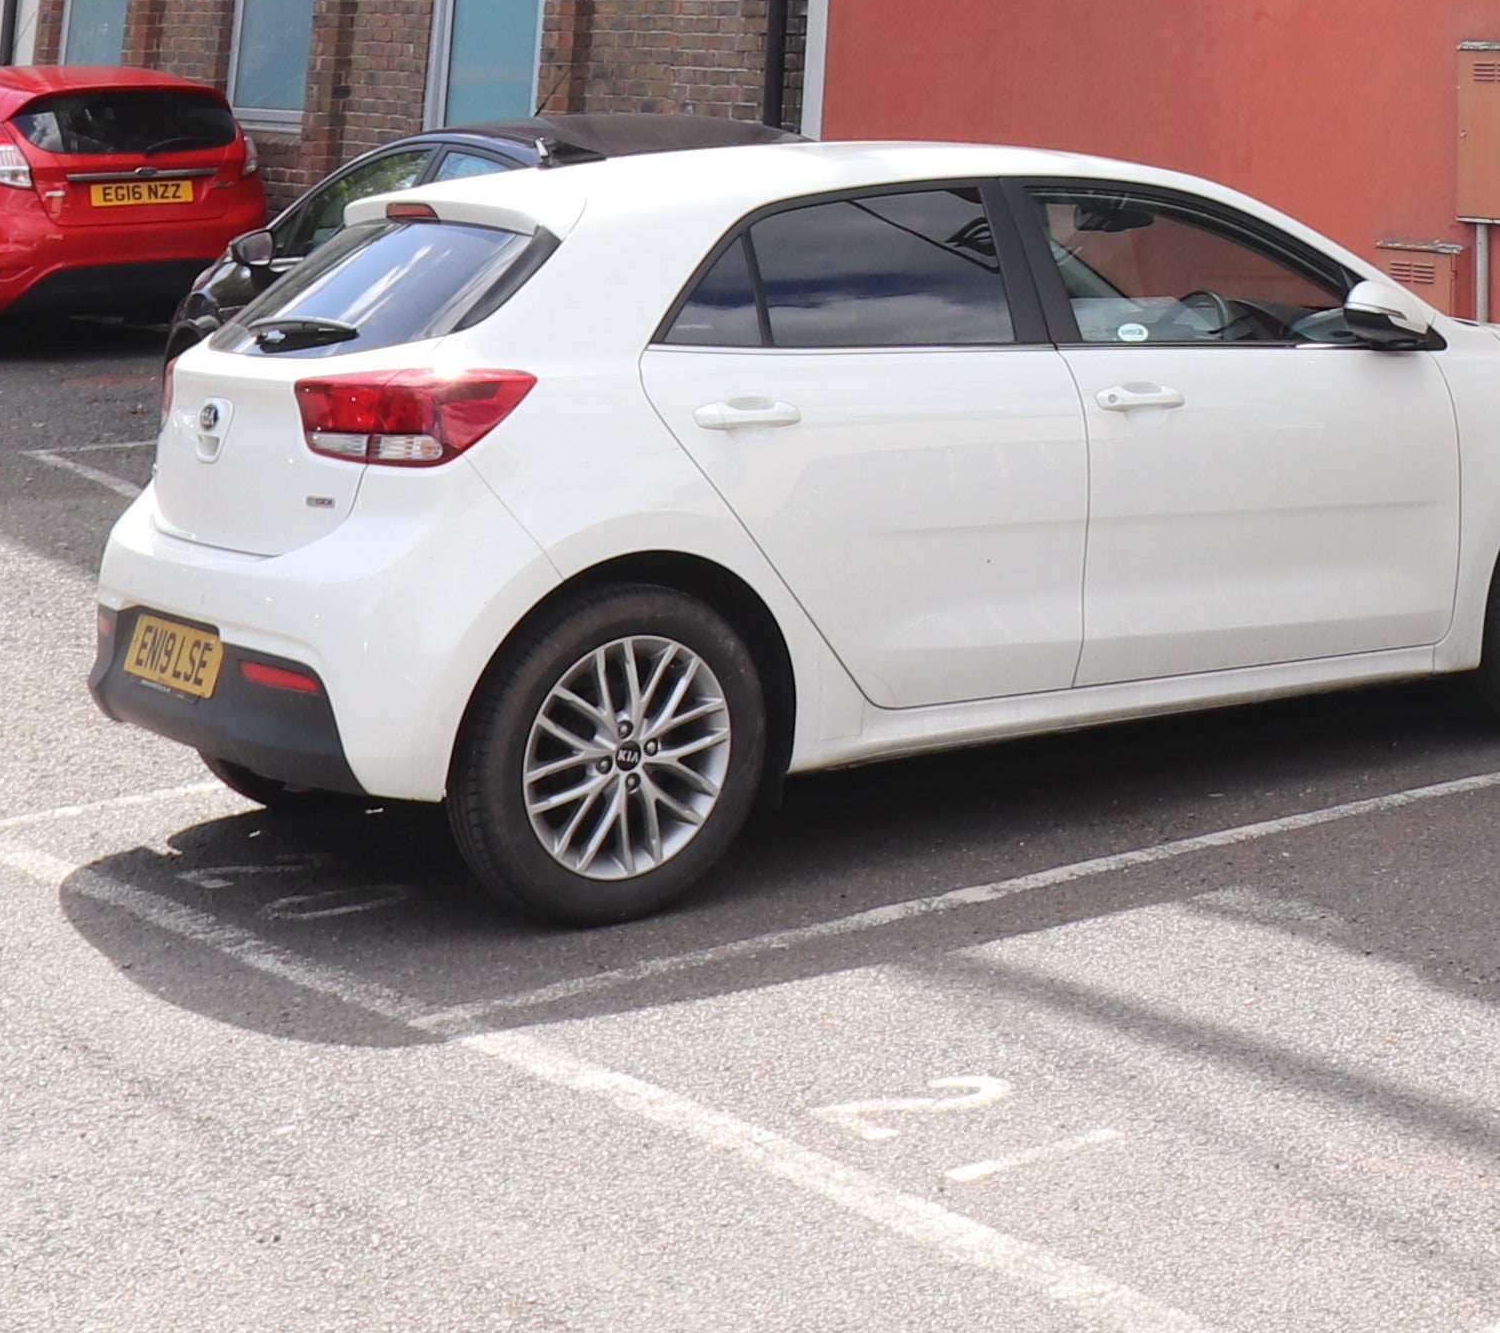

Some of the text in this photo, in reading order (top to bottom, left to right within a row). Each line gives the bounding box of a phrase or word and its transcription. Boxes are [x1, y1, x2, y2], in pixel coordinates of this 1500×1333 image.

[102, 183, 182, 202] EG16 NZZ
[134, 624, 214, 687] EN19 LSE
[616, 748, 639, 763] KIA
